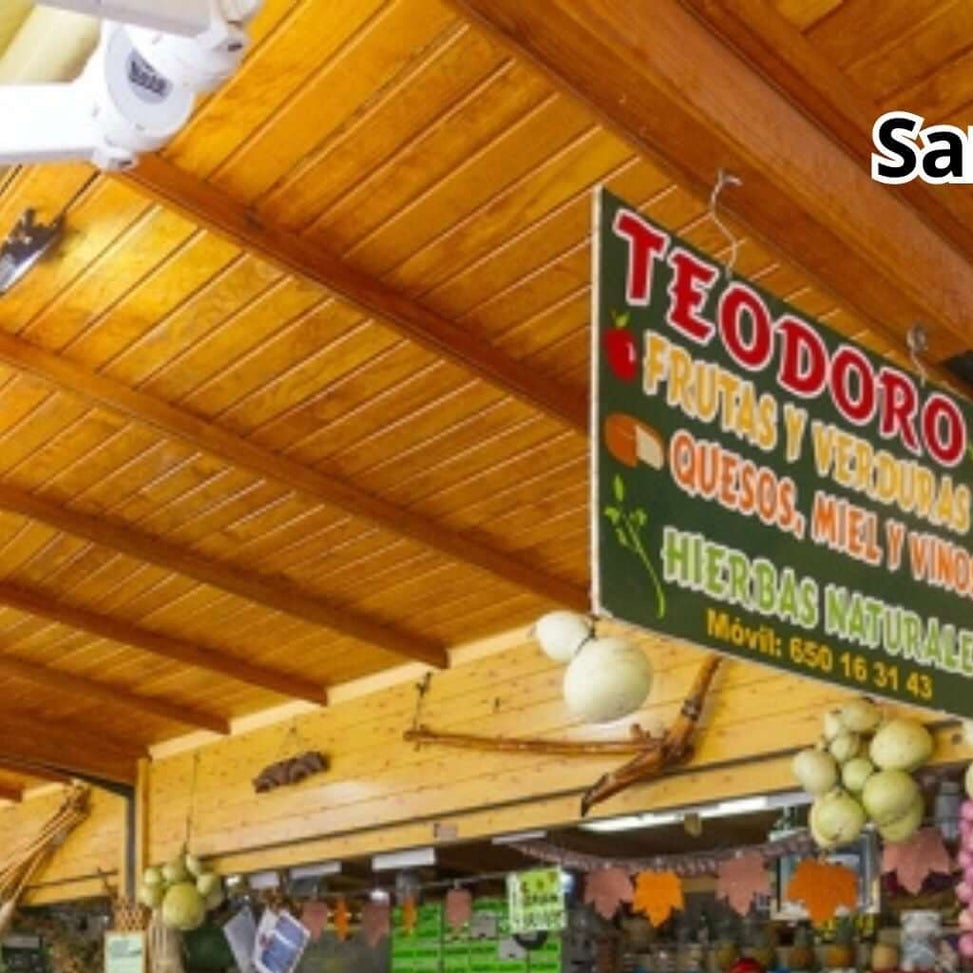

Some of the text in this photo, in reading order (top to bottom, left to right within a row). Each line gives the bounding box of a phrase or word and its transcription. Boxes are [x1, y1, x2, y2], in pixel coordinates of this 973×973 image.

[612, 208, 967, 468] TEODORO
[643, 331, 972, 536] FRUTAS Y VERDURAS
[670, 429, 806, 541] QUESOS,
[811, 489, 884, 567] MIEL
[886, 517, 906, 573] Y
[660, 525, 819, 630] HIERBAS
[706, 606, 934, 700] Móvil: 650 16 31 43
